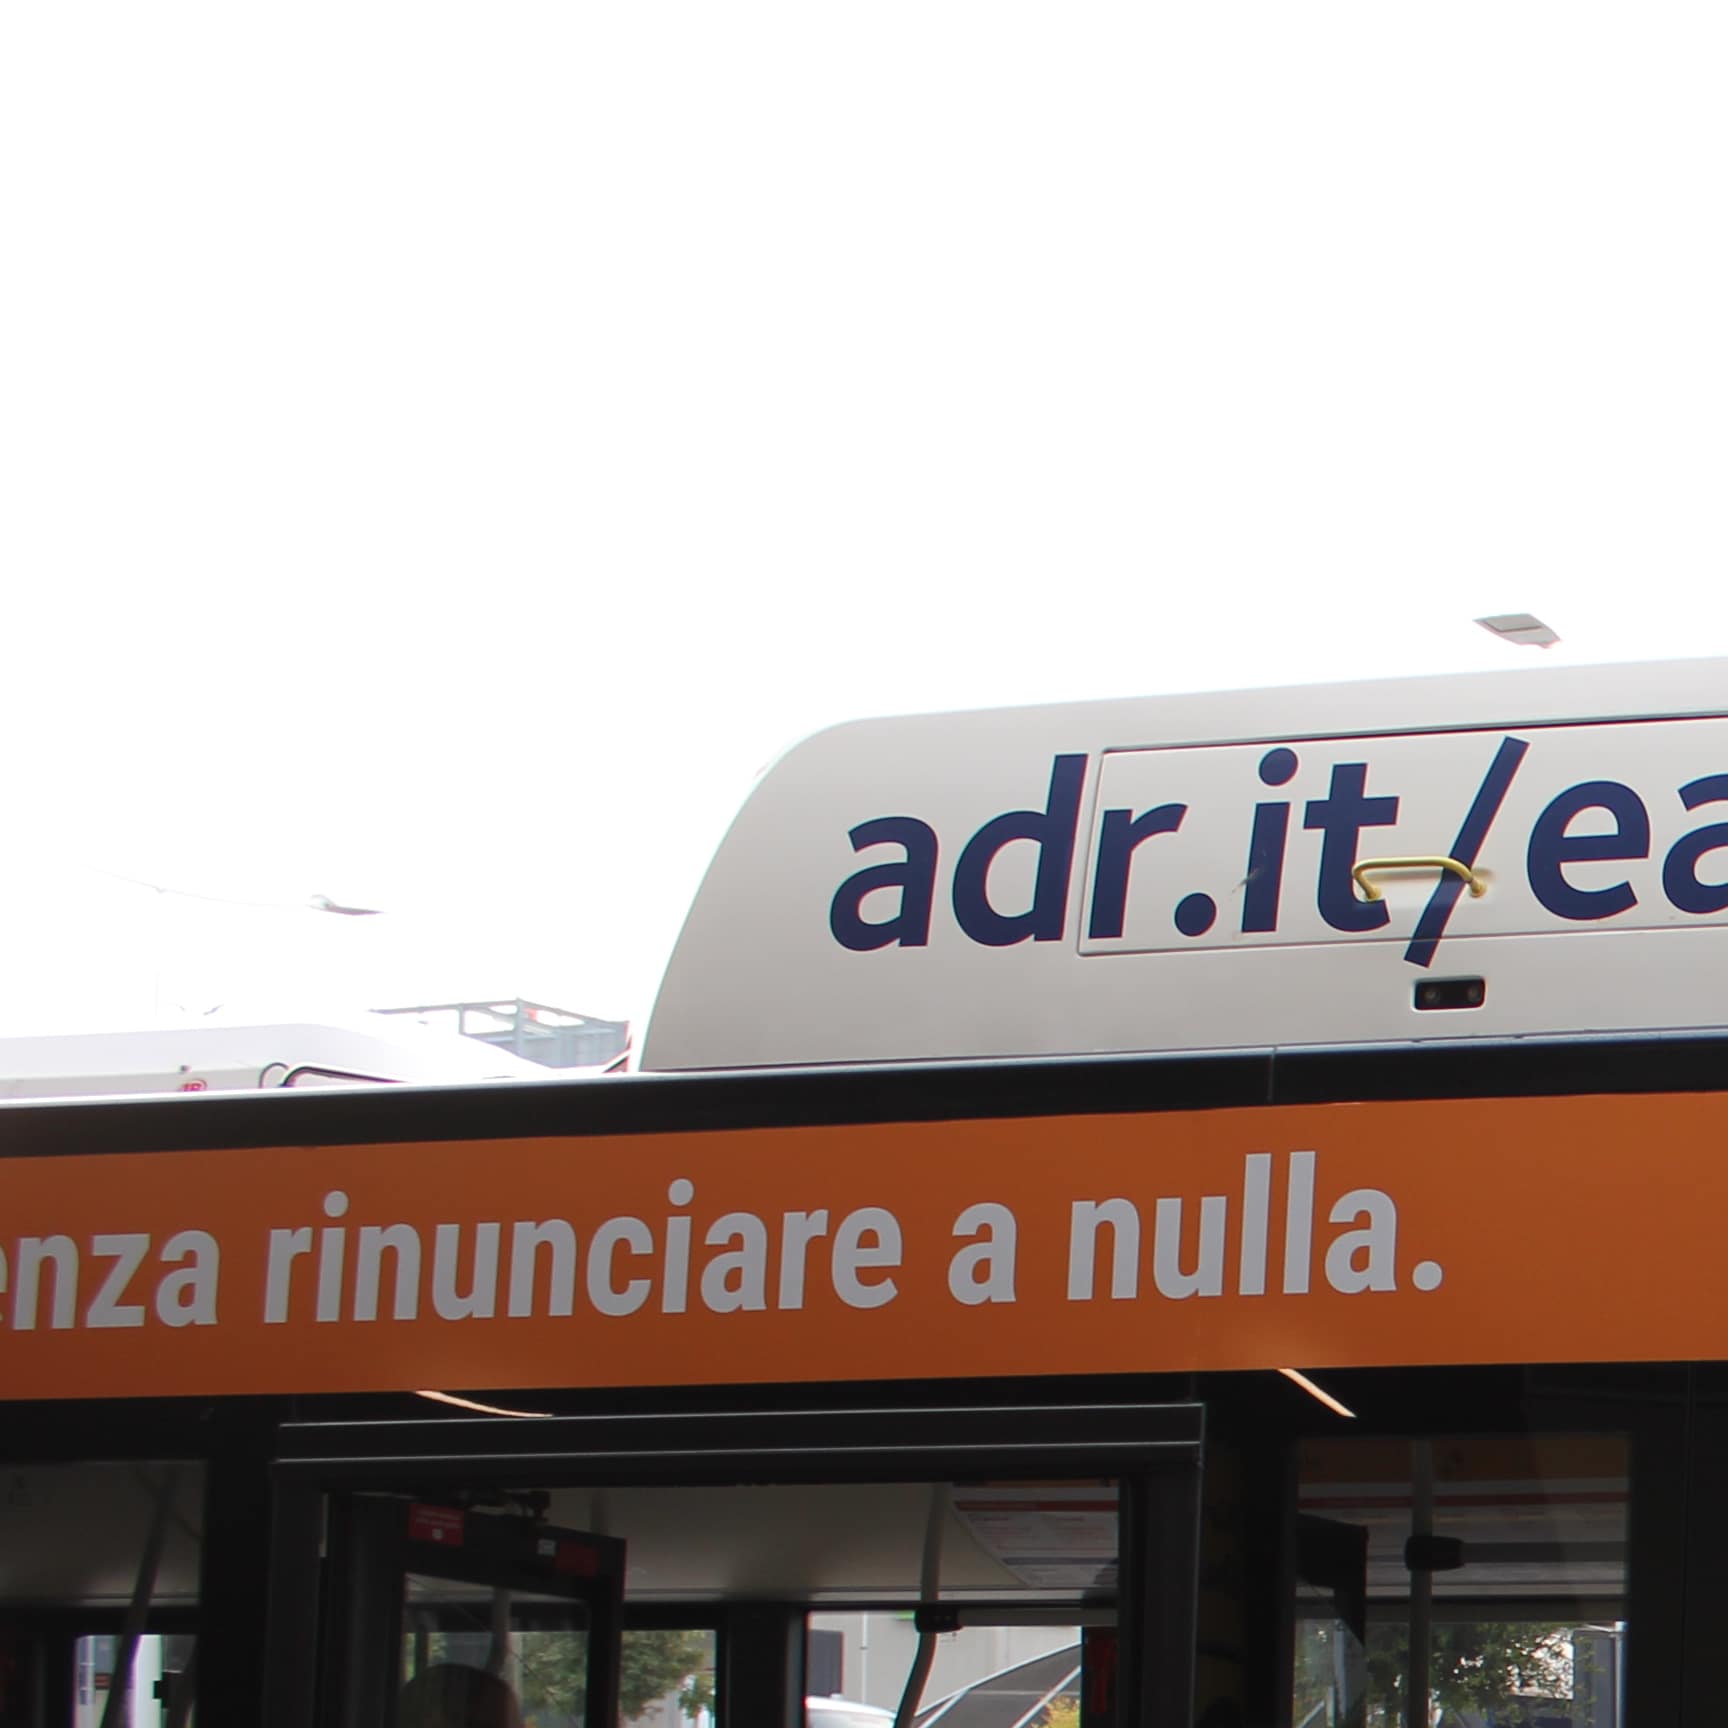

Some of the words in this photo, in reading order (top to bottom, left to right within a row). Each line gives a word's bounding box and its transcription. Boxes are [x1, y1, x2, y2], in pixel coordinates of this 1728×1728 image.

[0, 1229, 218, 1330] nza
[263, 1178, 904, 1325] rinunciare
[946, 1201, 1018, 1305] a
[1066, 1150, 1444, 1302] nulla.
